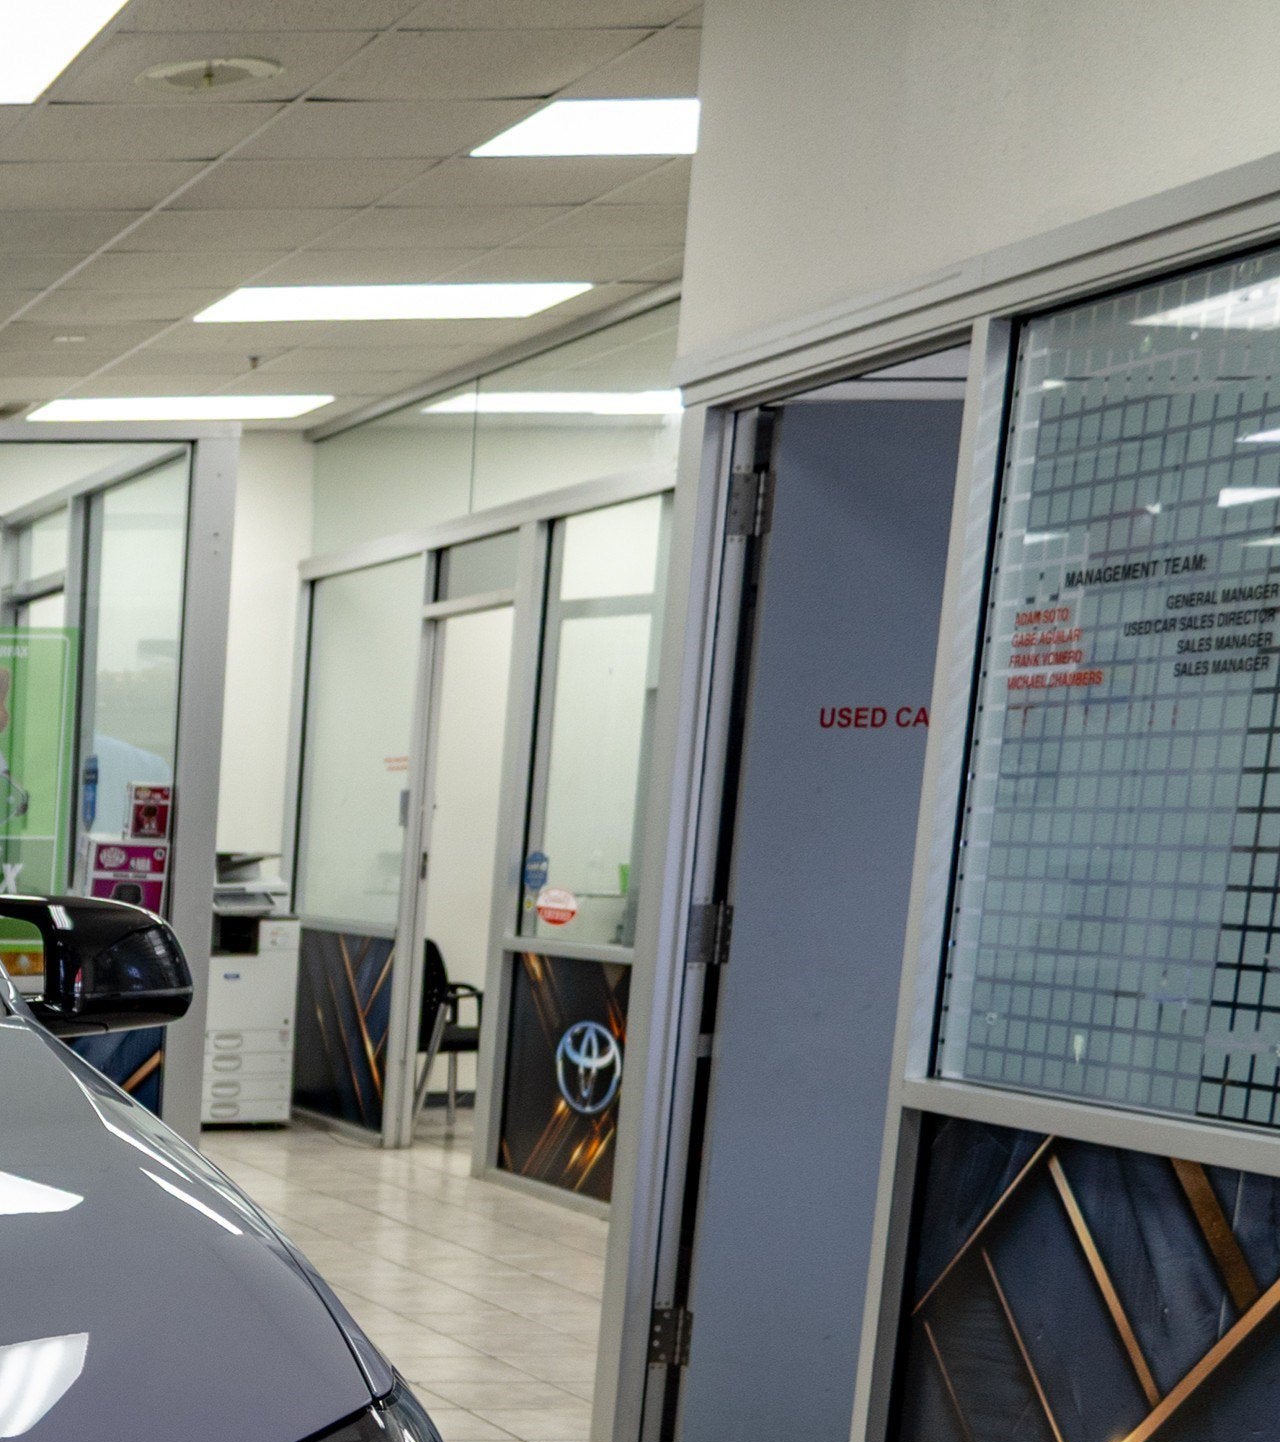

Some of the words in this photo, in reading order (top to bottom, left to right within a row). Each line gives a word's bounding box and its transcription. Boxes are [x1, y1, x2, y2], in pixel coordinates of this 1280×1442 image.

[1064, 562, 1158, 588] MANAGEMENT
[1164, 553, 1208, 576] TEAM:
[1165, 588, 1218, 610] GENERAL
[1221, 582, 1280, 603] MANAGER
[1123, 620, 1152, 637] USED
[1153, 617, 1176, 634] CAR
[1179, 612, 1215, 632] SALES
[1216, 607, 1277, 629] DIRECTOR
[1176, 637, 1212, 655] SALES
[1214, 631, 1274, 651] MANAGER
[1049, 669, 1103, 688] CHAMBERS
[1173, 660, 1210, 678] SALES
[1211, 655, 1270, 677] MANAGER
[819, 706, 888, 729] USED
[895, 706, 929, 728] CA
